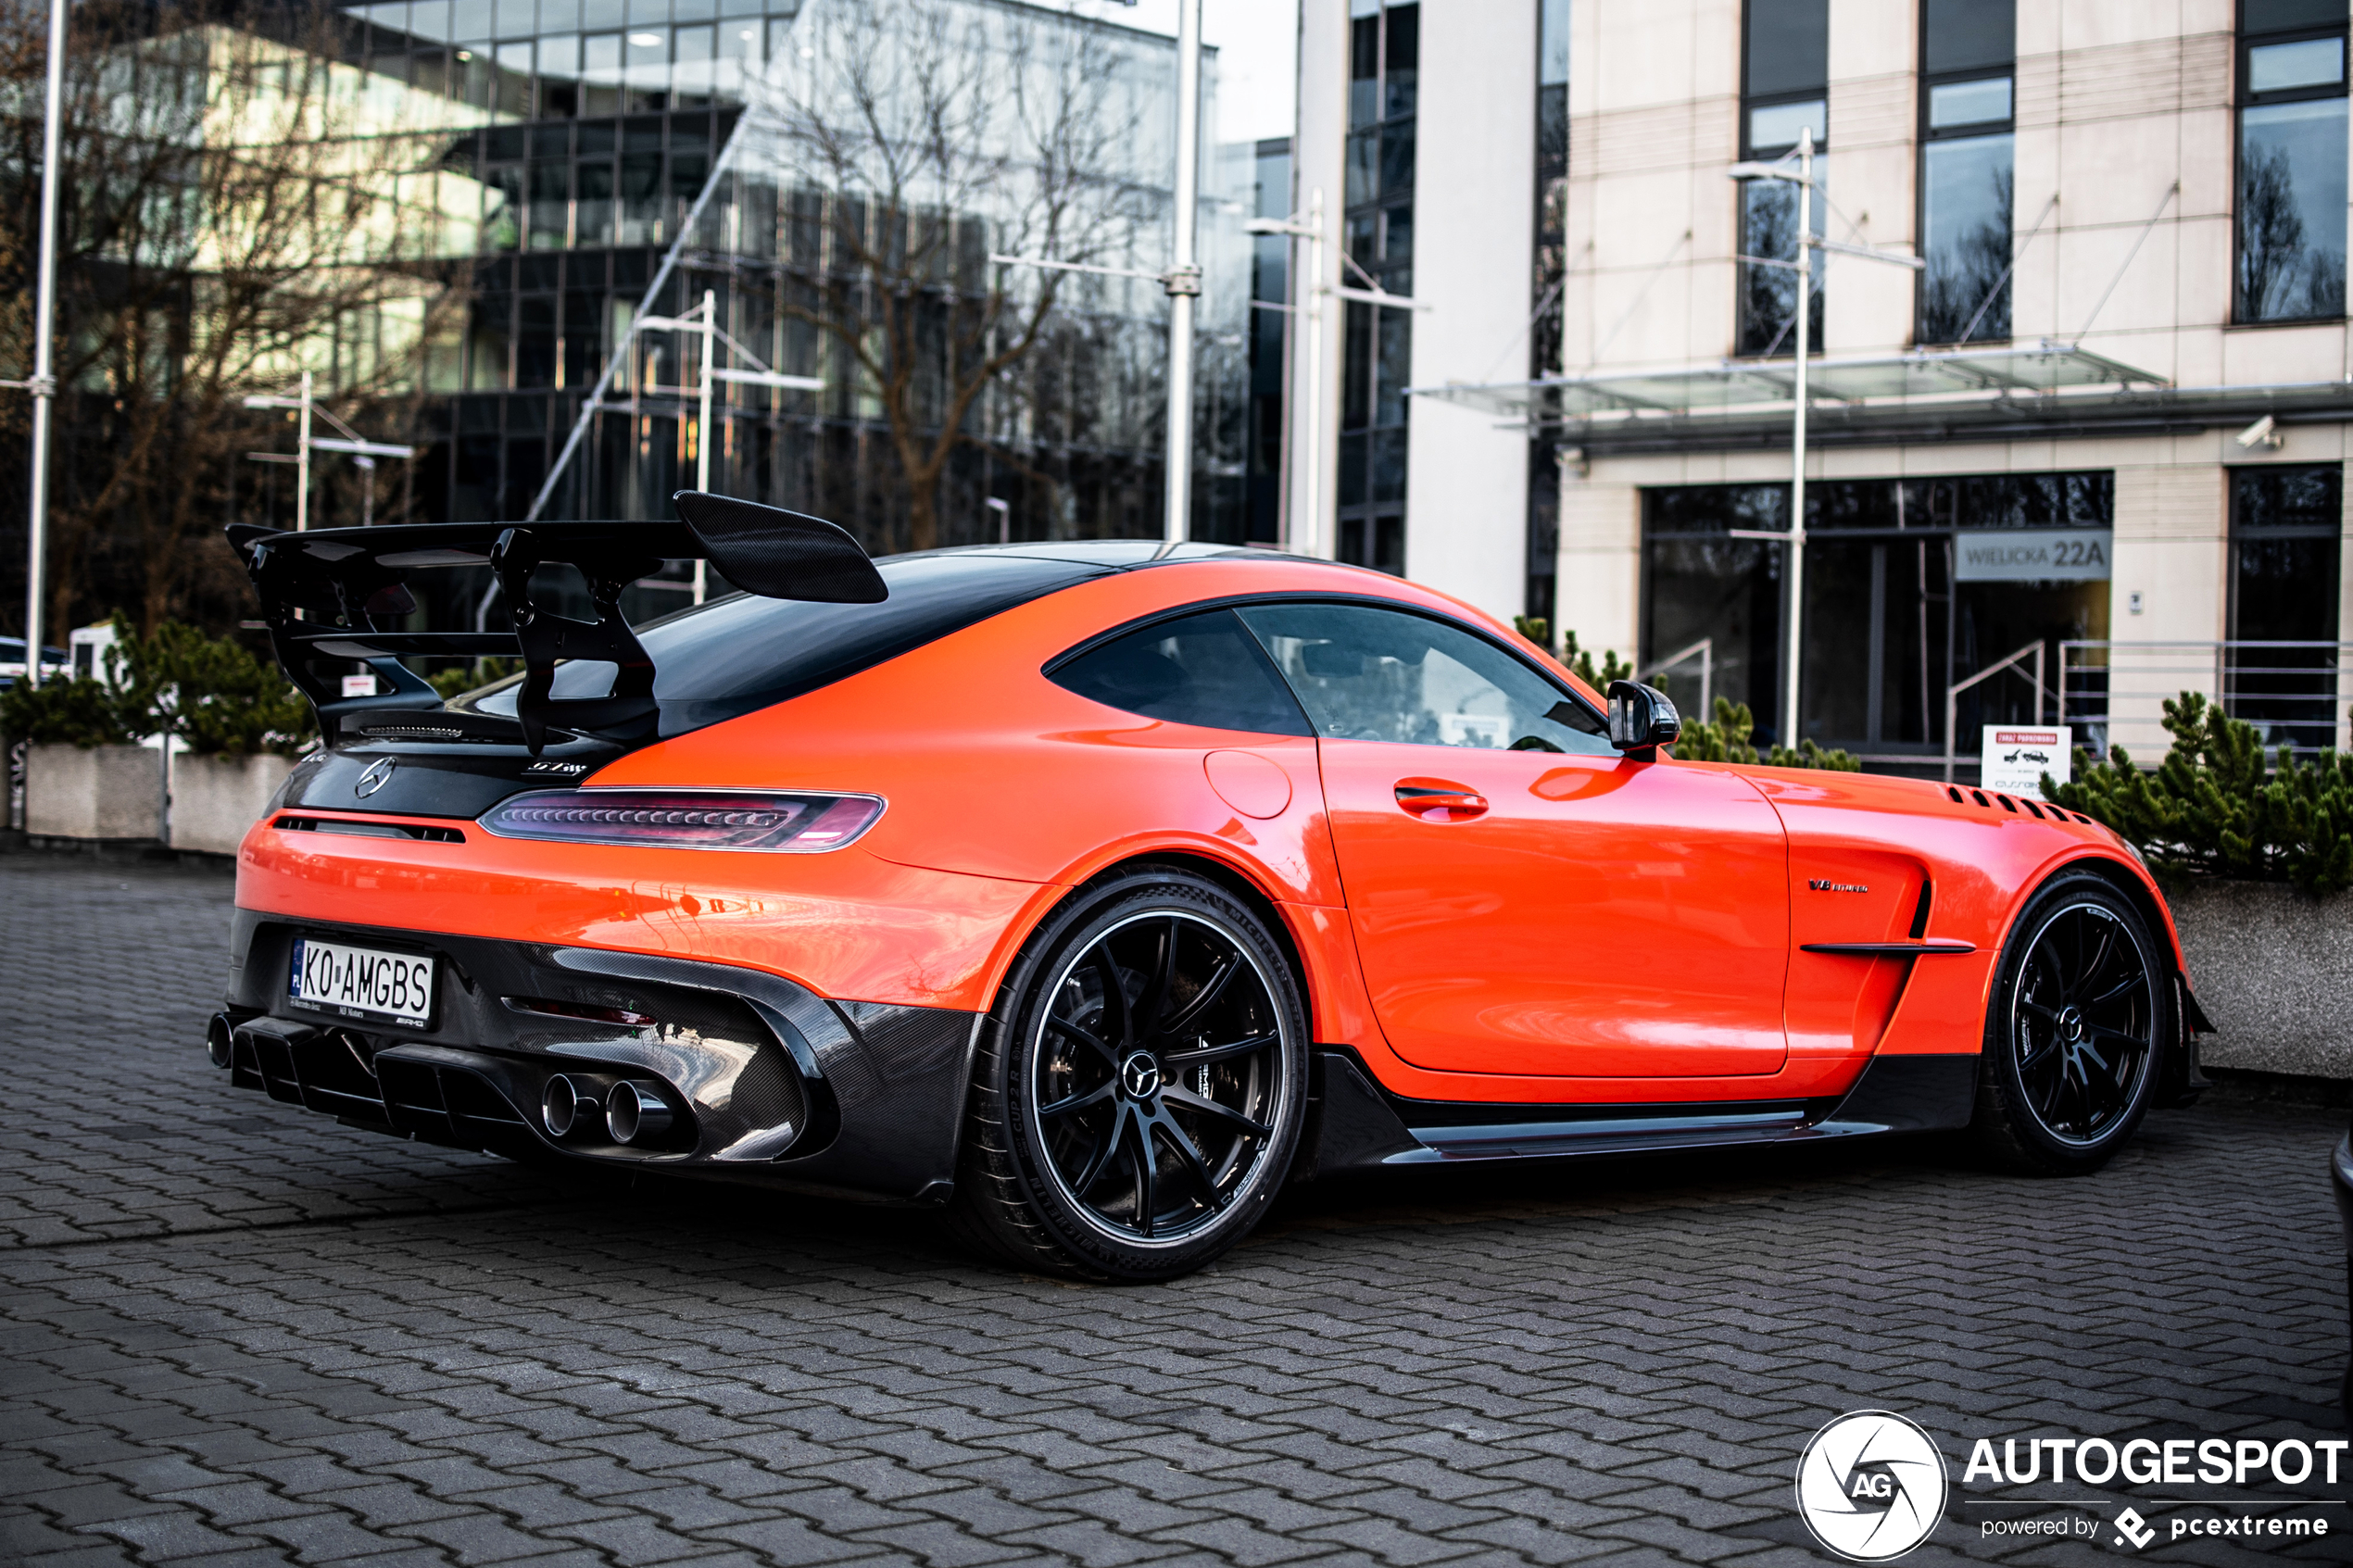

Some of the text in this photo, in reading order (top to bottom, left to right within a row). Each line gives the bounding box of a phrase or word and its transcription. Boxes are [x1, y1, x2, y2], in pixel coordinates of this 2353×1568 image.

[1967, 540, 2105, 567] WIELICKA 22A
[1809, 879, 1869, 893] V8 BITURBO
[1227, 908, 1287, 982] MICHELIN
[292, 974, 300, 988] PL
[341, 954, 428, 1012] AMGBS
[347, 1008, 364, 1018] Motors
[1010, 1071, 1023, 1133] CUP 2 R
[1029, 1177, 1097, 1251] MICHELIN
